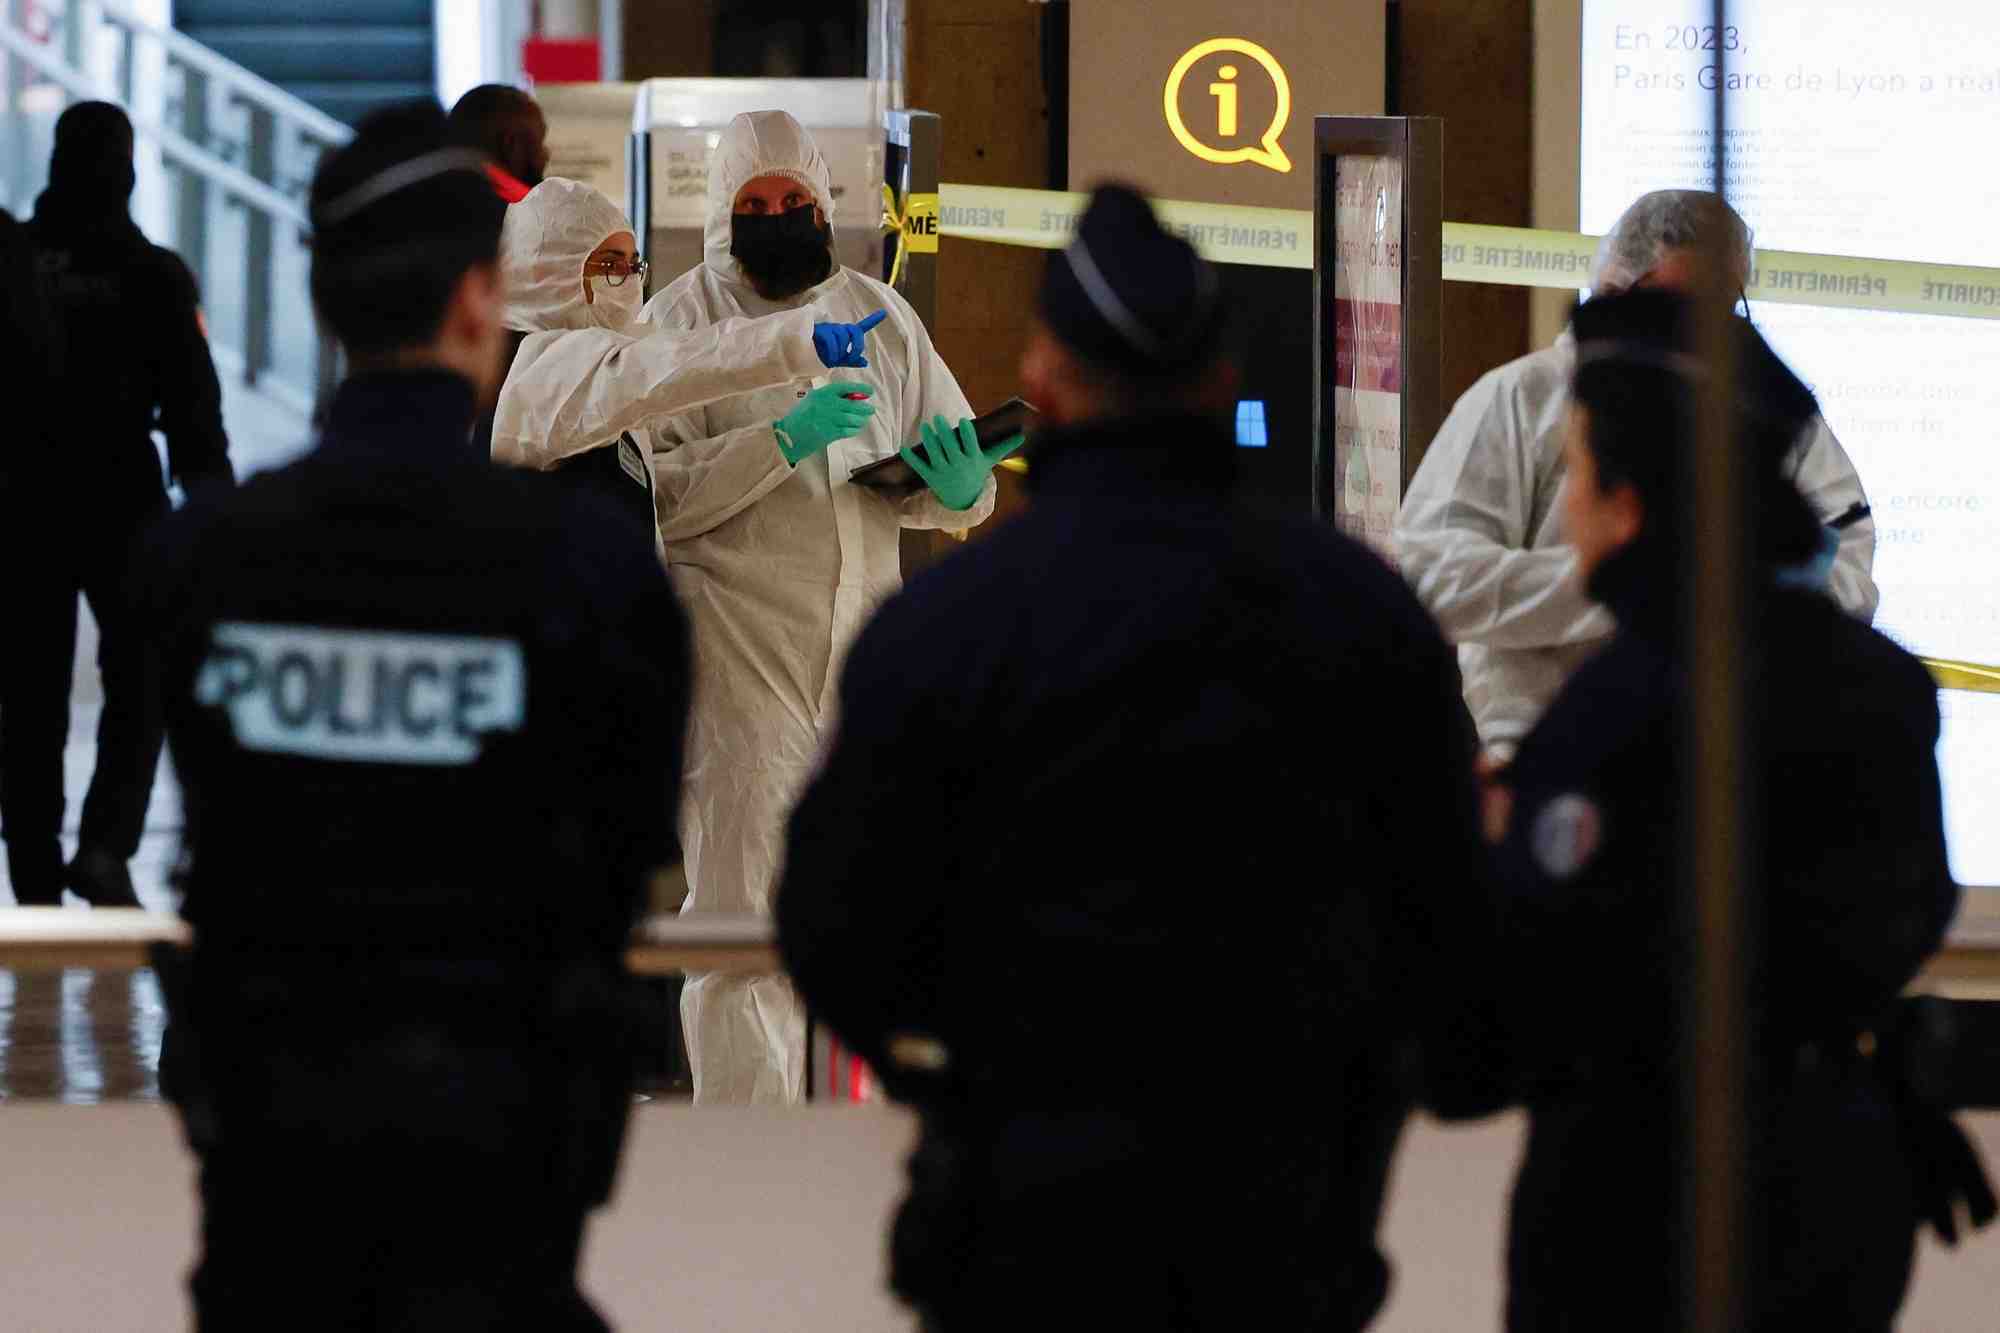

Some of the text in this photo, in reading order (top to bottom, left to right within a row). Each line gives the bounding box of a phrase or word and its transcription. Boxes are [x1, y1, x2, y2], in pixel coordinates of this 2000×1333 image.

[1615, 24, 1651, 50] En
[1614, 64, 1686, 91] Paris
[1697, 64, 1772, 91] Gare
[1784, 64, 1824, 92] de
[1835, 65, 1907, 104] Lyon
[1918, 73, 1935, 93] a
[215, 643, 499, 742] POLICE
